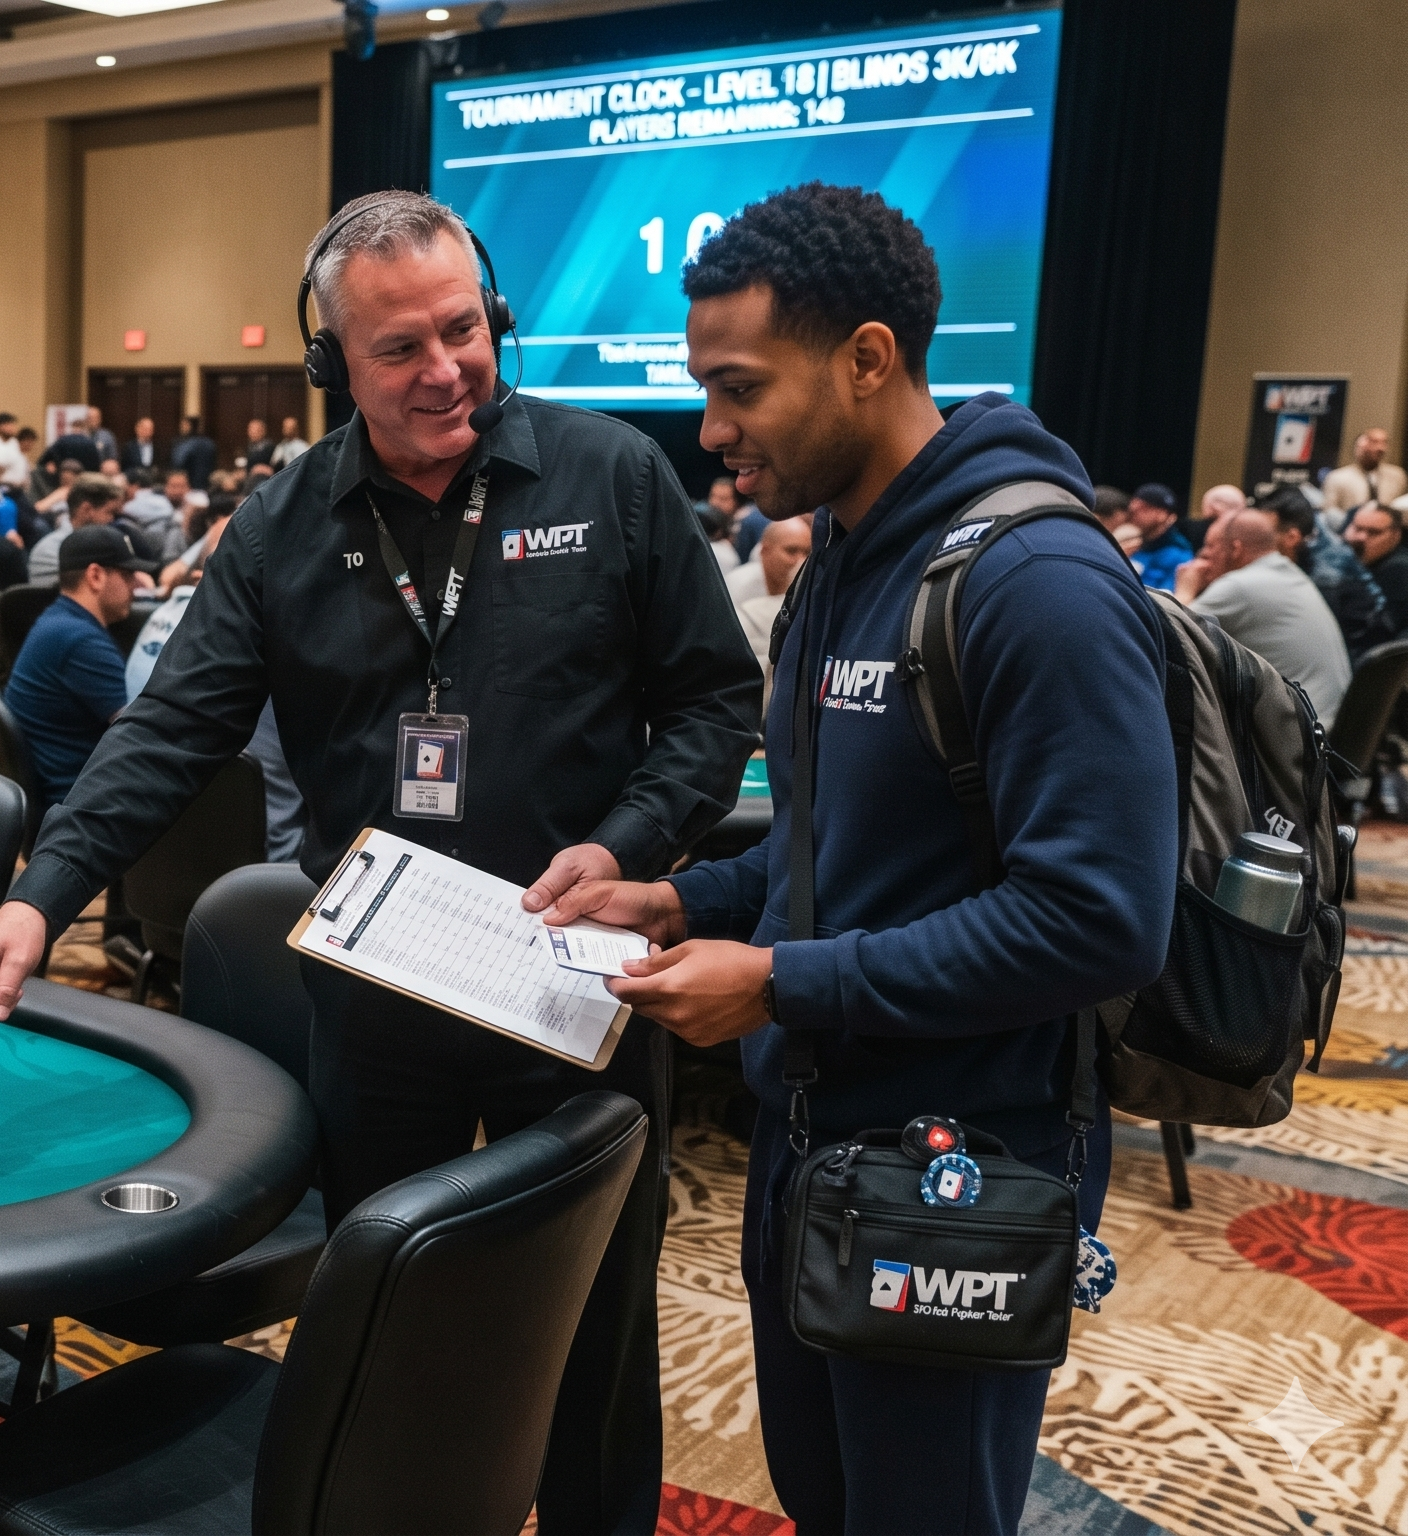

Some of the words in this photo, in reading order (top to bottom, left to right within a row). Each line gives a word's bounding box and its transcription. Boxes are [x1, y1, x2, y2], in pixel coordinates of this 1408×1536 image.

[459, 85, 607, 130] TOURNAMENT
[608, 76, 685, 114] CLOCK
[704, 67, 779, 105] LEVEL
[589, 111, 676, 145] PLAYERS
[523, 523, 589, 550] WPT
[343, 551, 364, 569] TO
[830, 659, 896, 699] WPT
[913, 1266, 1018, 1310] WPT
